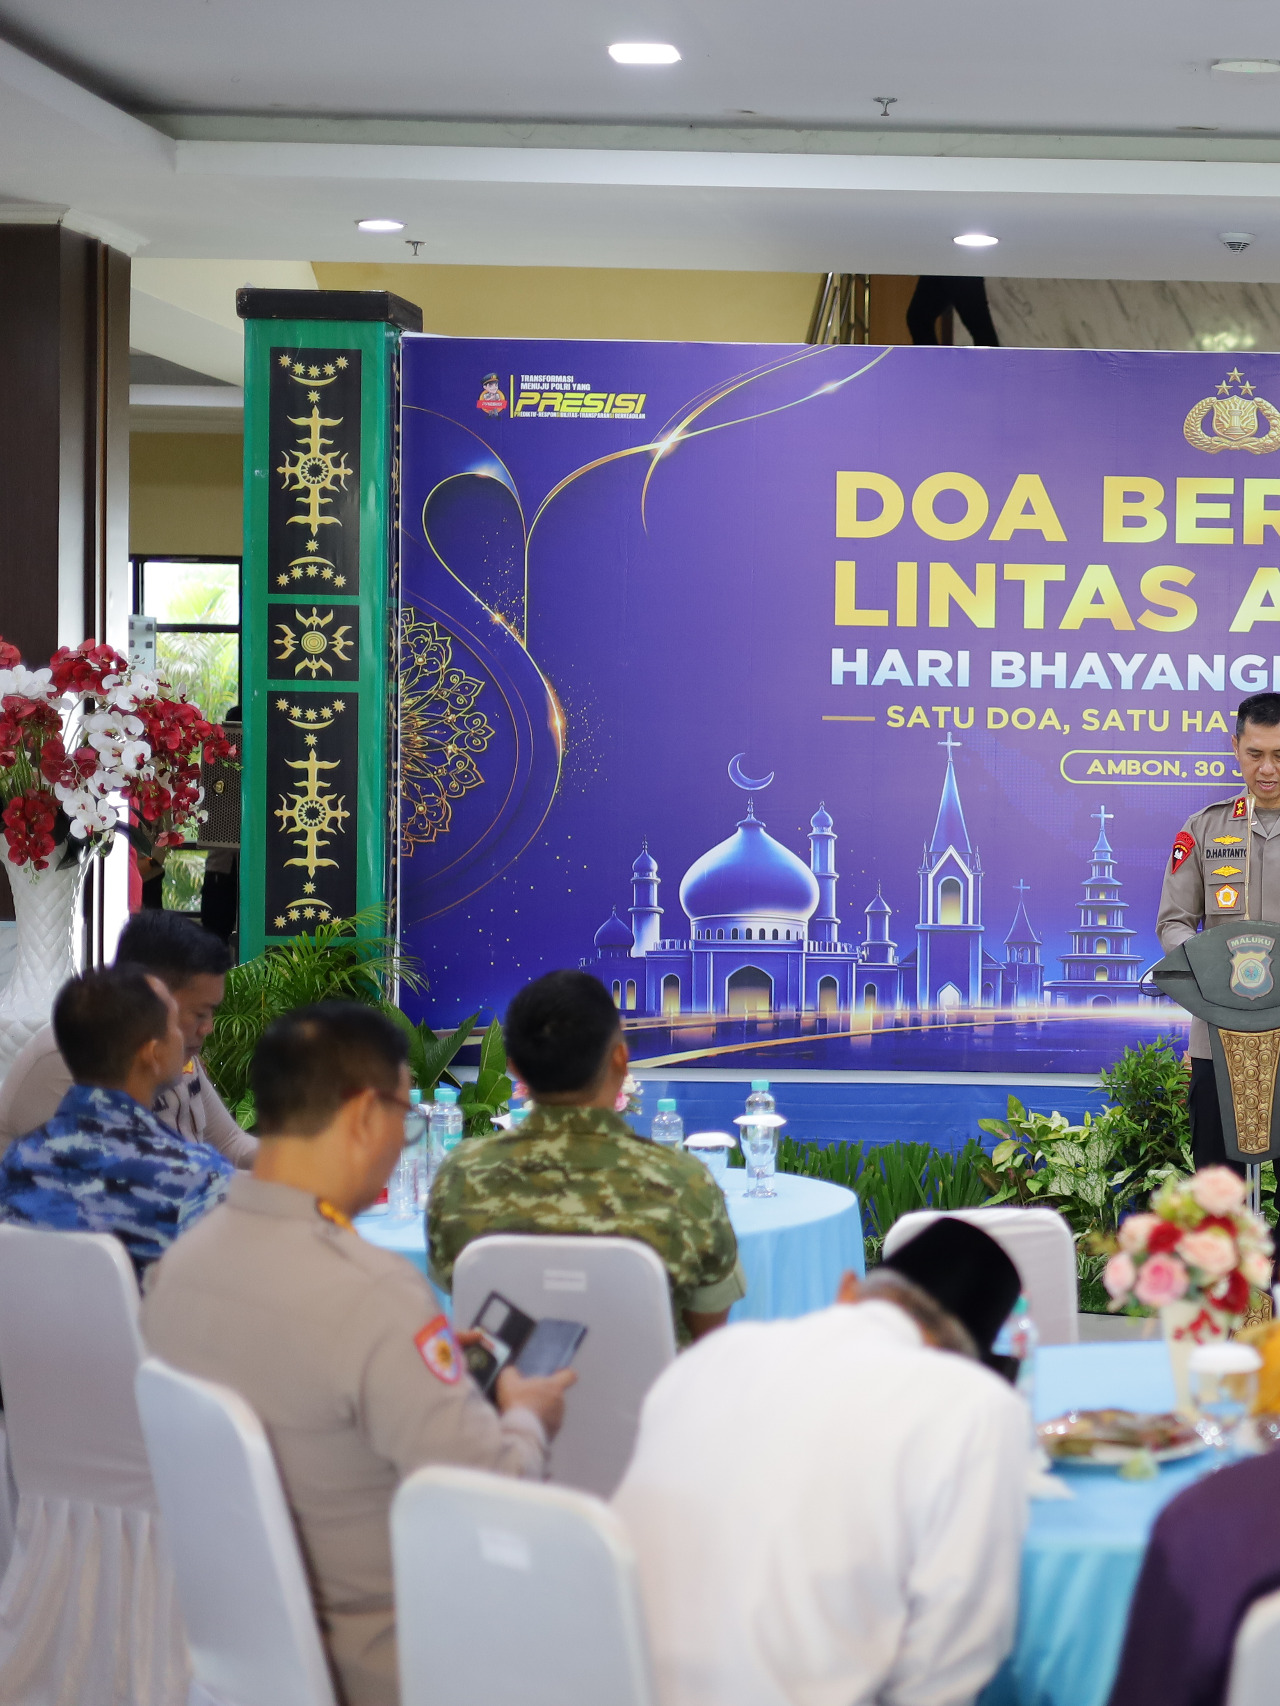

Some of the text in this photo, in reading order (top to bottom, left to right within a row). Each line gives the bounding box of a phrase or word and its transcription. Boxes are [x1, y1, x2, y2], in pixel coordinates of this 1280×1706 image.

[520, 374, 574, 383] TRANSFORMASI
[520, 382, 591, 391] MENUJU POLRI YANG
[515, 391, 647, 414] PRESISI
[834, 470, 1069, 542] DOA
[833, 559, 1199, 633] LINTAS
[830, 647, 971, 688] HARI
[885, 704, 975, 731] SATU
[986, 706, 1071, 736] DOA,
[1081, 708, 1170, 734] SATU
[1086, 758, 1188, 781] AMBON,
[1194, 760, 1226, 778] 30
[1230, 936, 1273, 948] MALUKU
